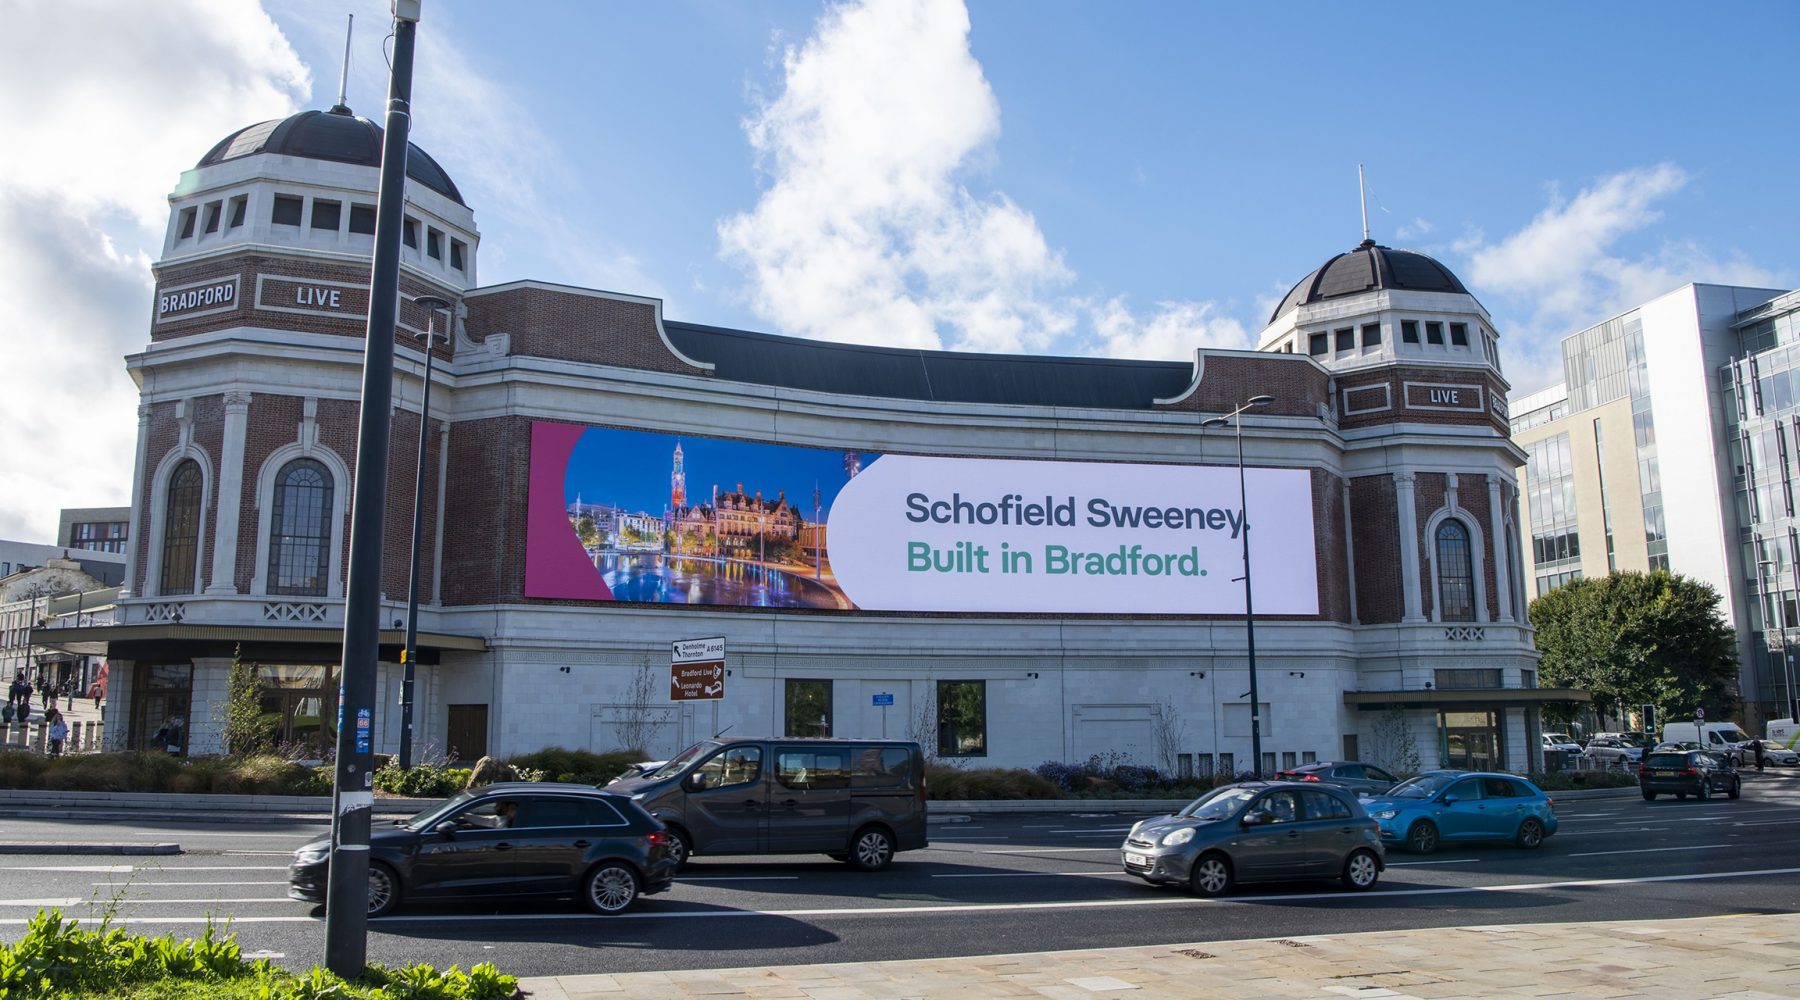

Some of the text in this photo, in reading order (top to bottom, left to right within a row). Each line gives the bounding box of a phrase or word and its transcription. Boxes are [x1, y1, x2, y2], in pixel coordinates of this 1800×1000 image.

[161, 284, 233, 313] BRADFORD
[296, 287, 340, 307] LIVE
[1430, 389, 1458, 404] LIVE
[905, 493, 1076, 527] Schofield
[907, 541, 1208, 577] Built in Bradford.
[682, 643, 705, 651] Denholme
[681, 669, 702, 677] Bradford
[681, 682, 702, 690] Leonardo
